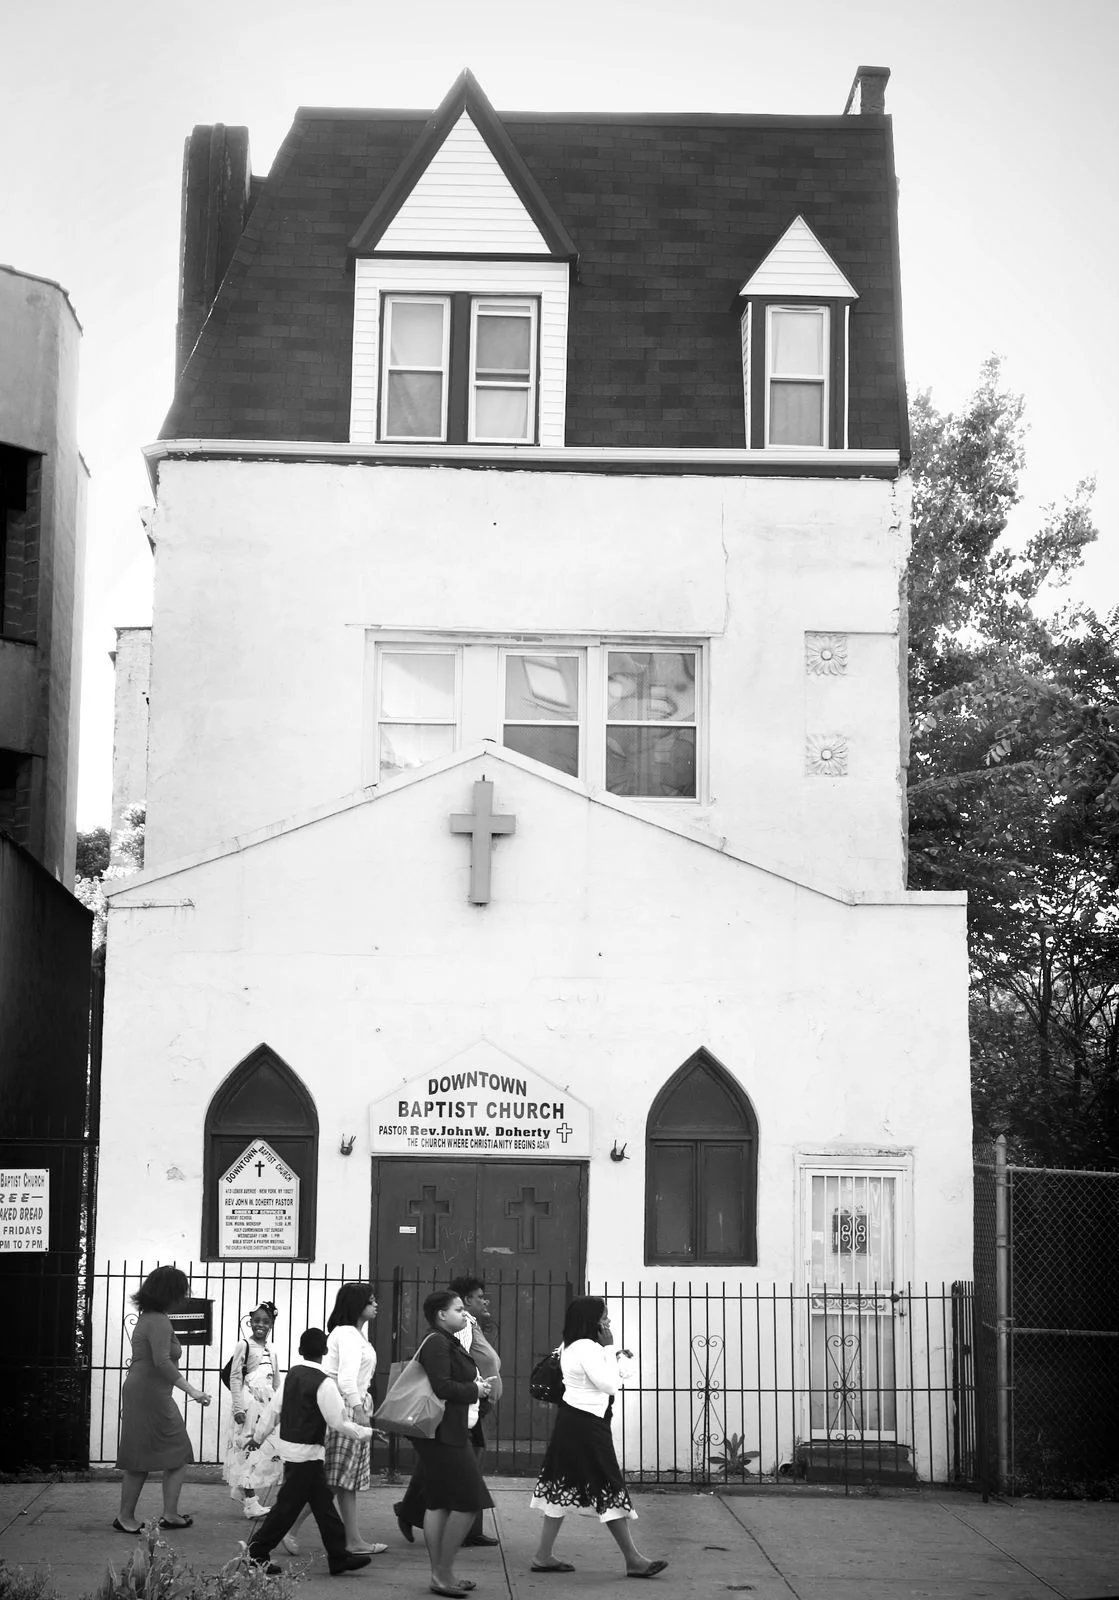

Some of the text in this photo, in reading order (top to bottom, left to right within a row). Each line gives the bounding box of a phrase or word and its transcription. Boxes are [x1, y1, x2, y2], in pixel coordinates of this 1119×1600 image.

[428, 1070, 527, 1097] DOWNTOWN
[398, 1101, 564, 1119] BAPTIST CHURCH
[378, 1125, 407, 1135] PASTOR
[495, 1126, 551, 1139] Doherty
[407, 1138, 550, 1149] THE CHURCH WHERE CHRISTIANITY BEGINS AGAIN
[225, 1146, 294, 1184] DOWNTOWN BAPTIST CHURCH
[235, 1198, 248, 1206] JOHN
[255, 1198, 274, 1206] DOHERTY
[275, 1198, 293, 1206] PASTOR
[0, 1207, 43, 1221] AKED BREAD
[3, 1226, 42, 1235] FRIDAYS
[13, 1240, 23, 1248] TO
[25, 1240, 30, 1248] 7
[32, 1240, 43, 1248] PM
